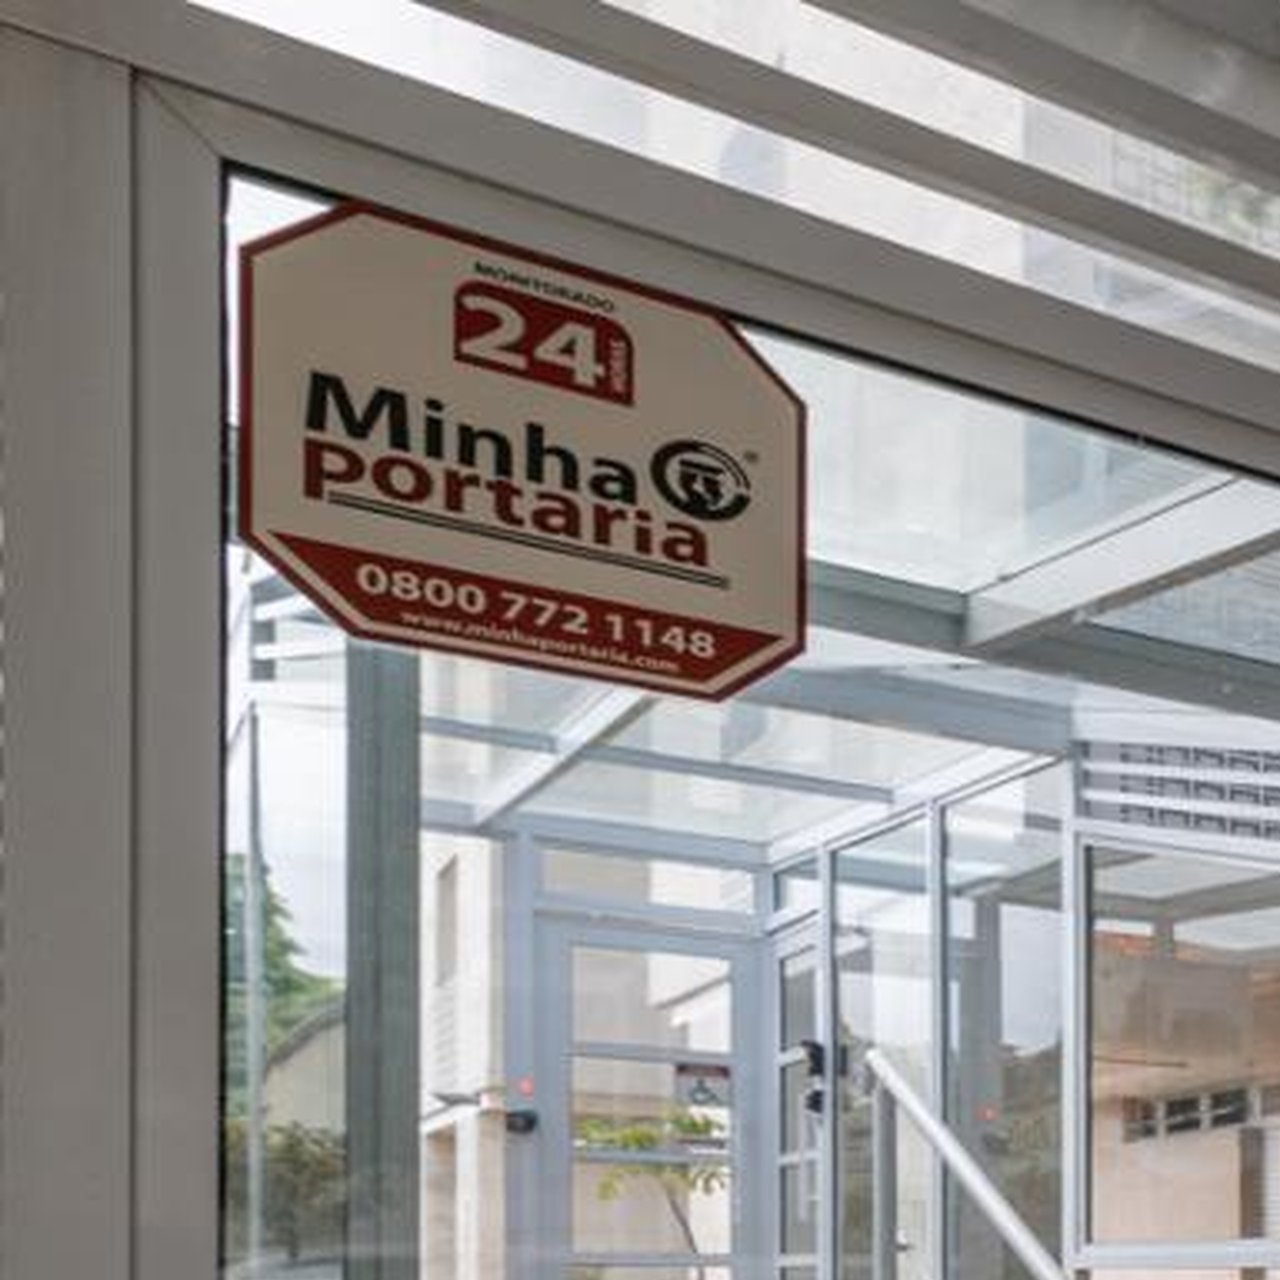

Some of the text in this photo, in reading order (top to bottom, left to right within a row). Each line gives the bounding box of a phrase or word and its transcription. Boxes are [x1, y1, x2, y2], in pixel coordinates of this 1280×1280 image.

[459, 294, 606, 388] 24
[304, 370, 638, 506] Minha
[355, 563, 717, 660] 0800 772 1148
